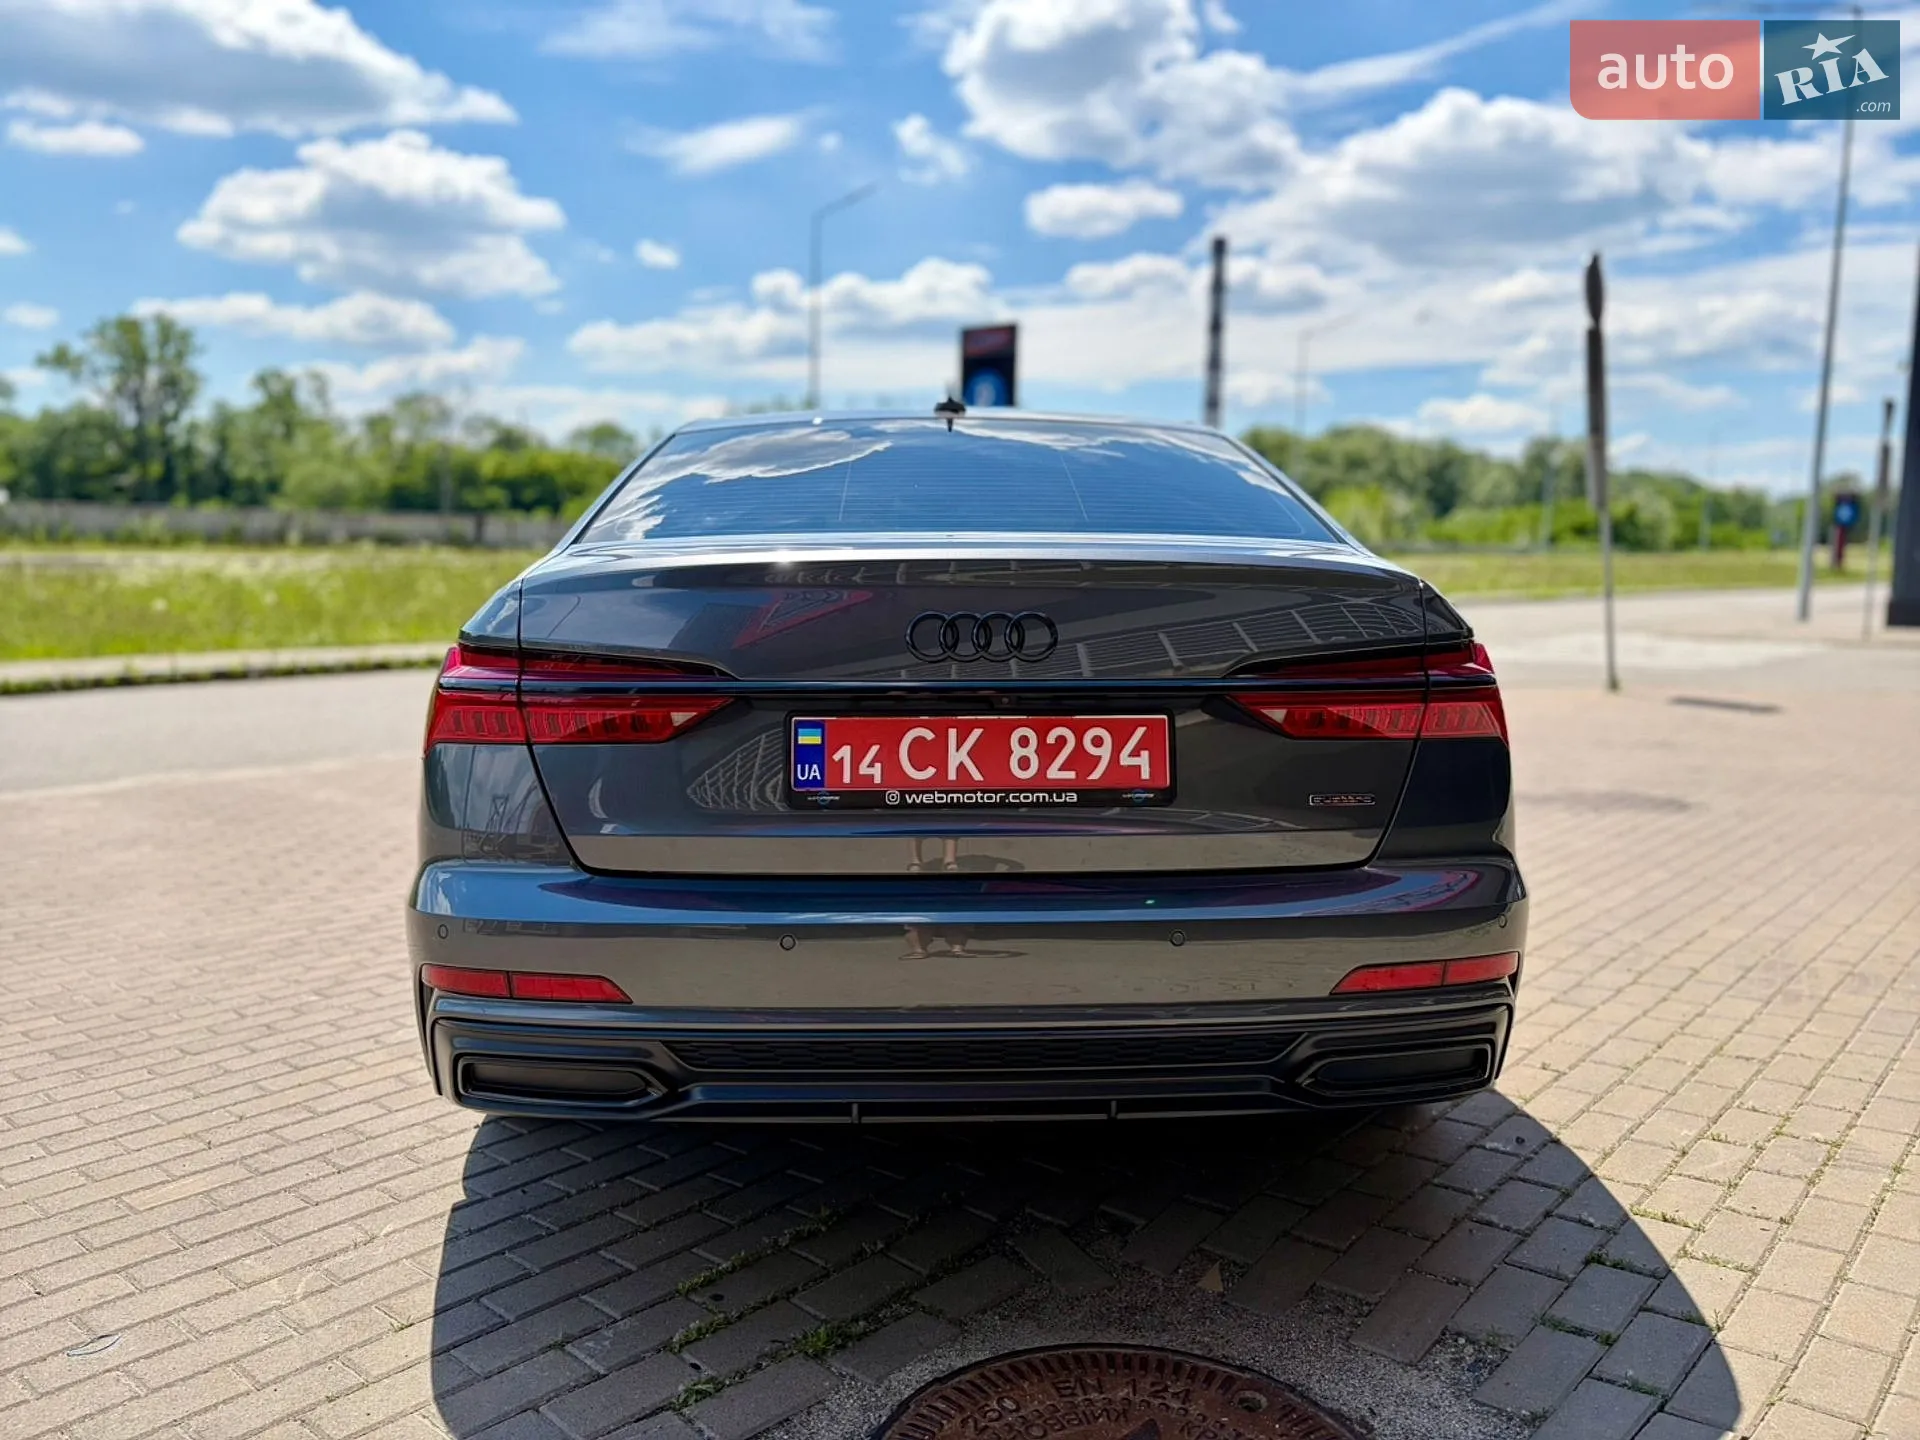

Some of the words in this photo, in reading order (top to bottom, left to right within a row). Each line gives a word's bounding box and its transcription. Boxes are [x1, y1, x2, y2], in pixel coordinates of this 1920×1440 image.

[831, 744, 882, 784] 14
[899, 726, 985, 782] CK
[1009, 726, 1152, 781] 8294
[796, 764, 822, 781] UA
[904, 789, 1078, 804] webmotor.com.ua
